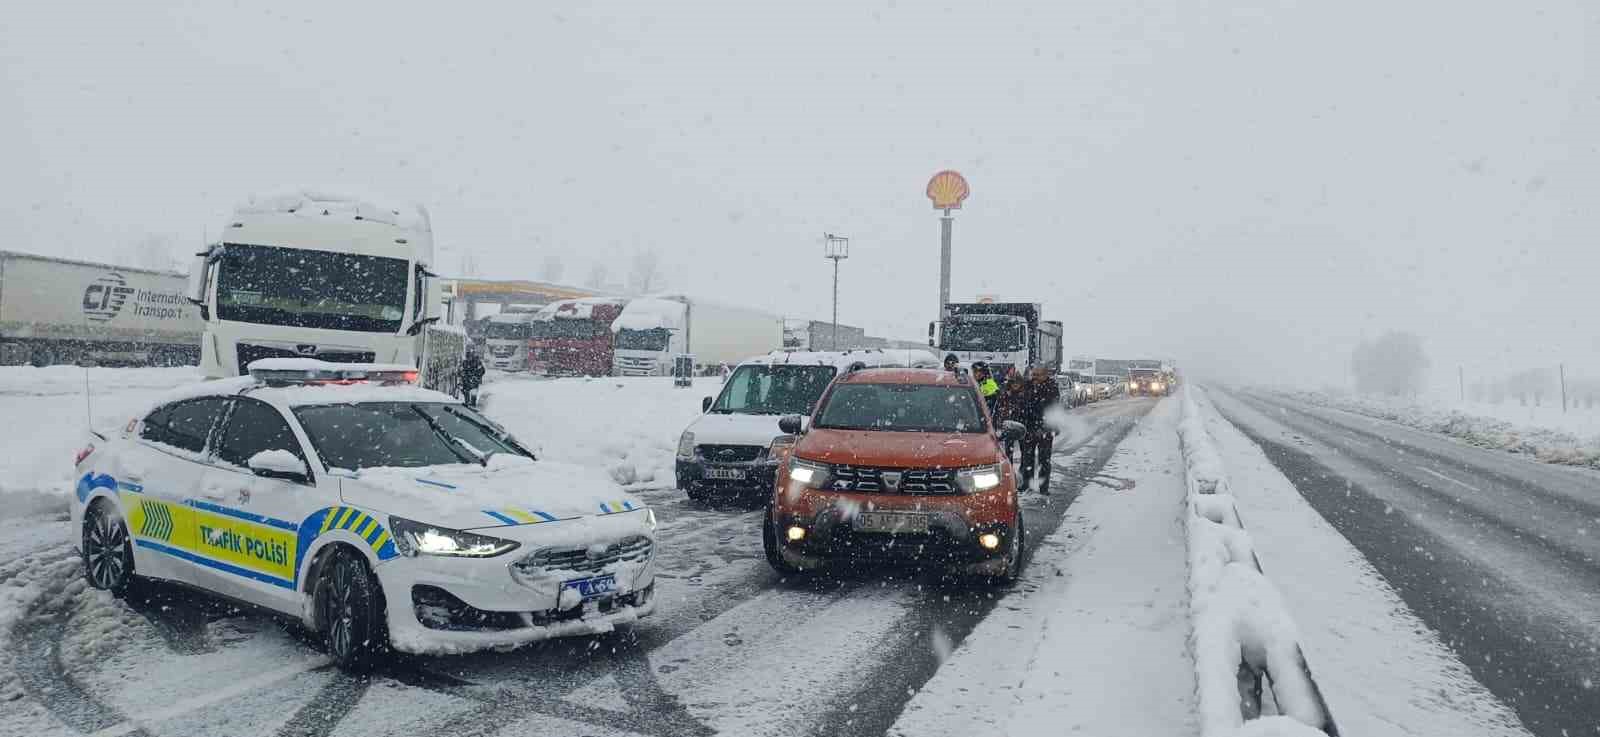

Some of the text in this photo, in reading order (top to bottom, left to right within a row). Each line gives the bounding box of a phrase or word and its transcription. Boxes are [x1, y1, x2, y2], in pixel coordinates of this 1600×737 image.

[136, 288, 192, 305] Internation
[134, 302, 182, 320] Transport
[245, 537, 288, 567] POLİSİ
